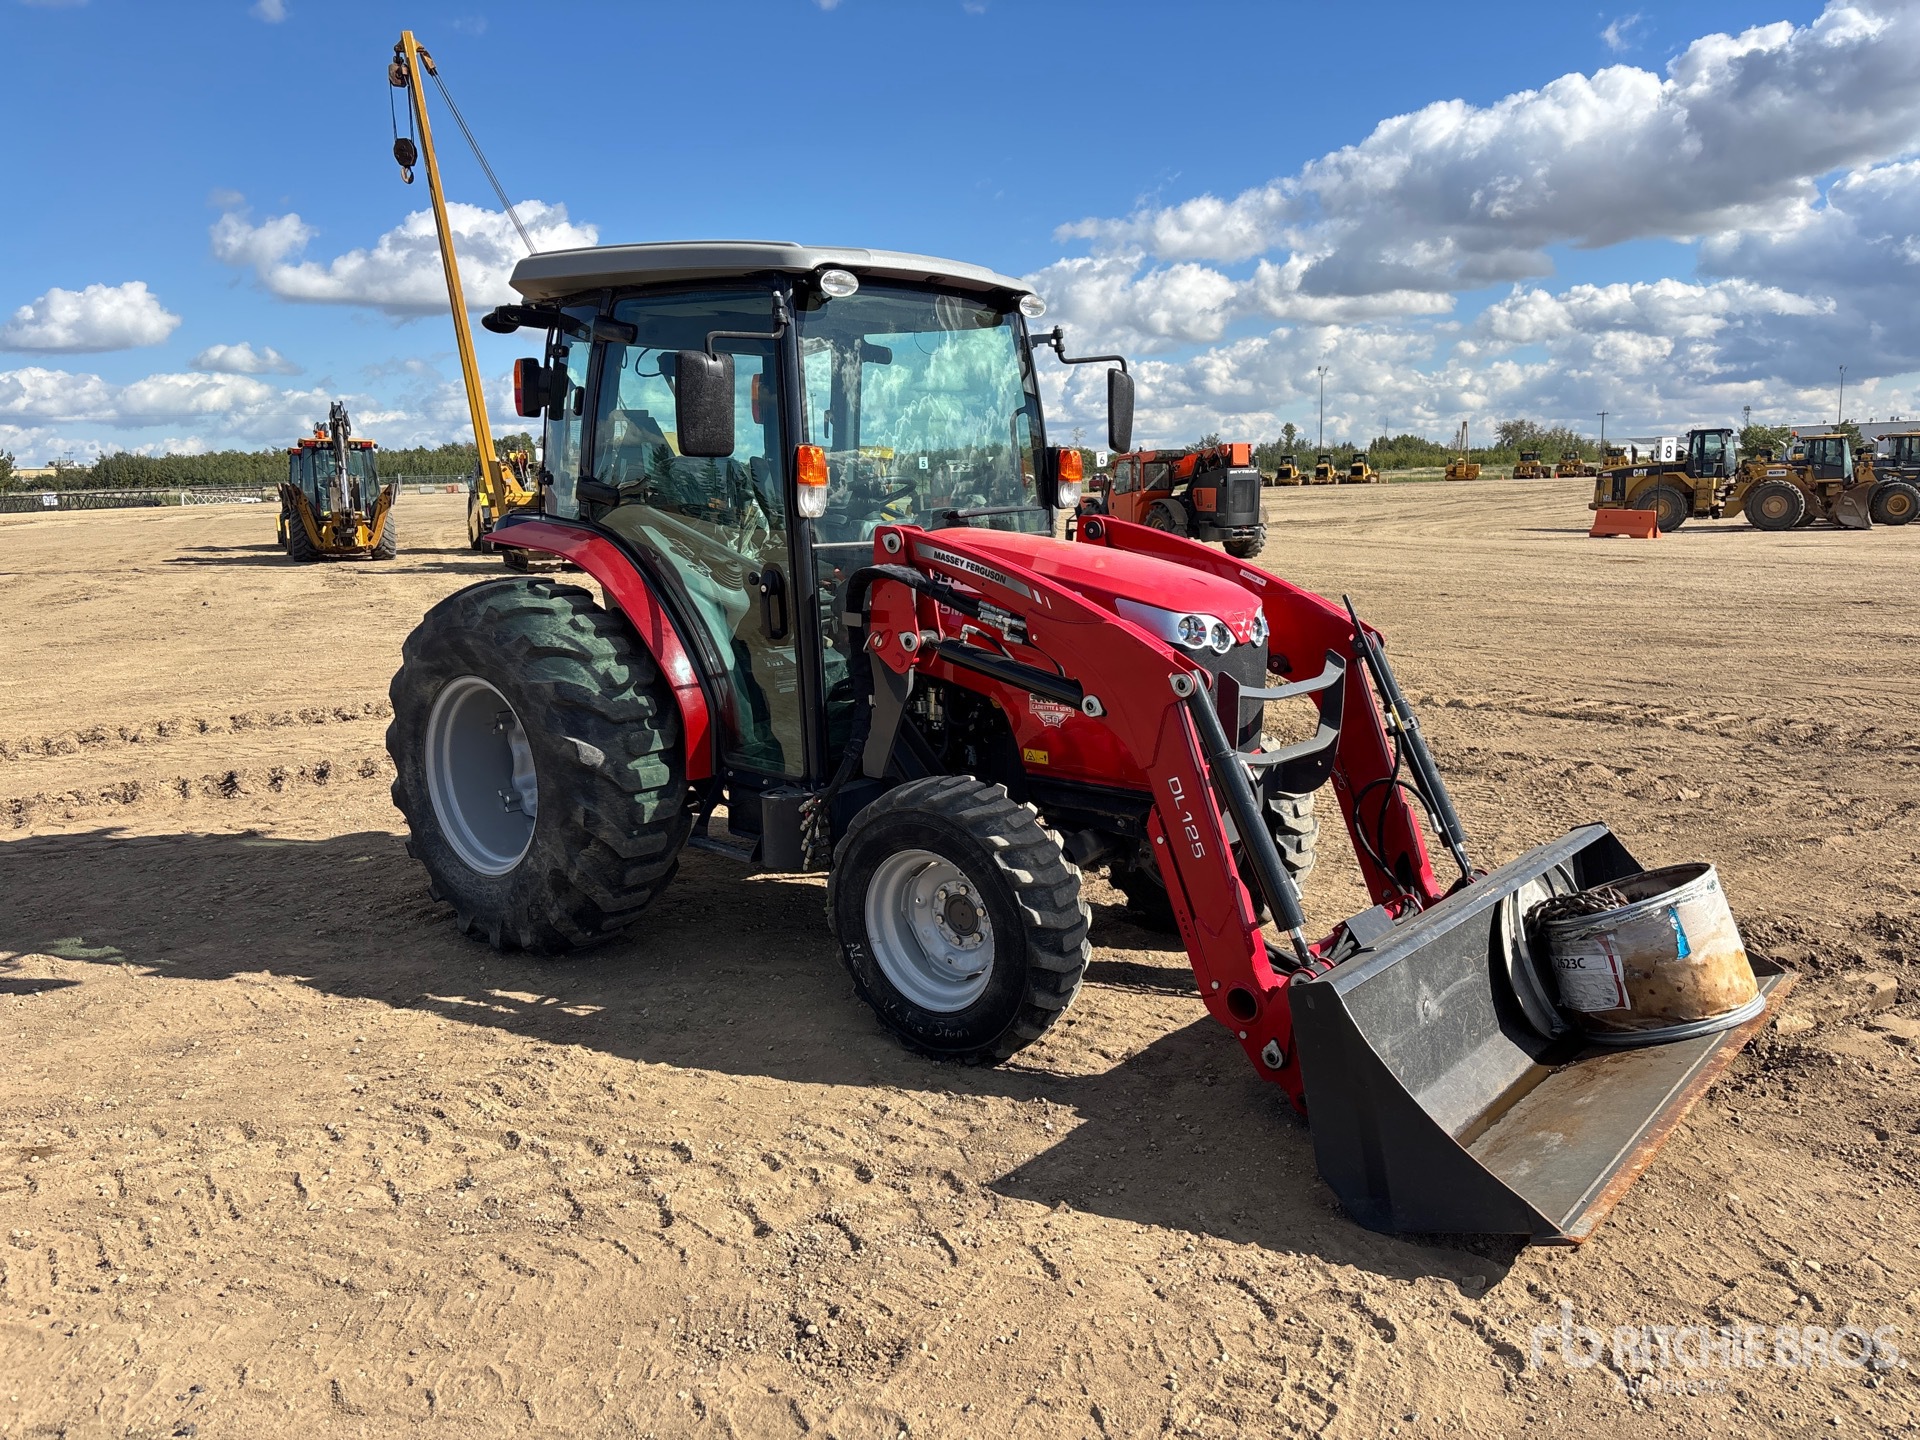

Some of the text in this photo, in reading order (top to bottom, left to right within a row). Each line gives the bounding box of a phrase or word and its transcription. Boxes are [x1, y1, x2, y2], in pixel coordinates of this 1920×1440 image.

[1665, 445, 1672, 459] 8
[921, 460, 926, 468] 5
[1099, 456, 1105, 465] 6
[1633, 468, 1648, 477] CAT
[933, 550, 1006, 584] MASSEY FERGUSON
[1045, 715, 1059, 724] 50
[1168, 776, 1206, 858] DL 125
